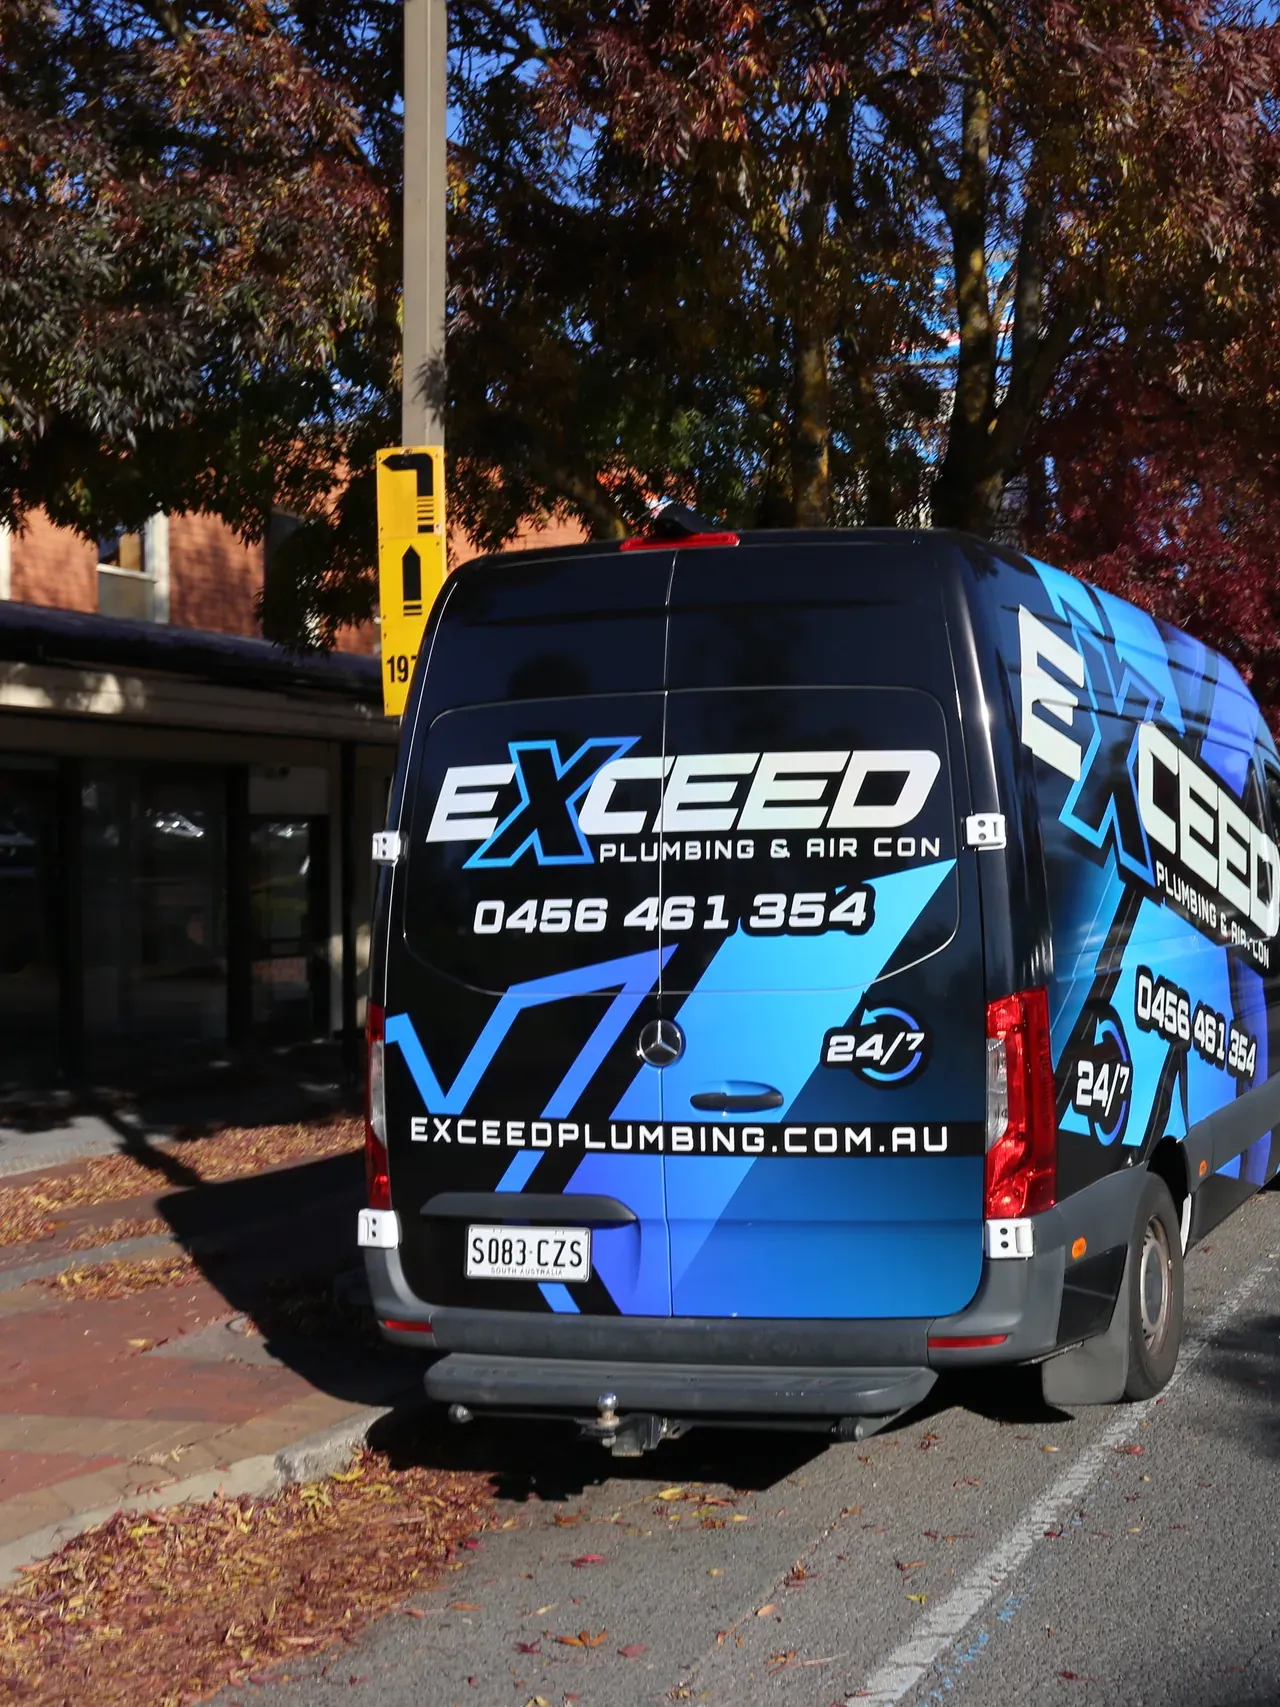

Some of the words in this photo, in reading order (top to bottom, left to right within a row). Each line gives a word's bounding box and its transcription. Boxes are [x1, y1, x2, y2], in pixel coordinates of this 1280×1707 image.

[1019, 604, 1280, 938] EXCEED
[426, 736, 941, 869] EXCEED
[600, 838, 754, 863] PLUMBING
[770, 838, 790, 858] &
[806, 837, 858, 858] AIR
[873, 837, 940, 858] CON
[473, 898, 608, 934] 0456
[623, 895, 730, 931] 461
[749, 891, 867, 928] 354
[1156, 860, 1217, 929] PLUMBING
[826, 1032, 925, 1066] 24/7
[1137, 974, 1190, 1041] 0456
[1194, 1009, 1225, 1061] 461
[1228, 1028, 1256, 1077] 354
[1076, 1060, 1129, 1117] 24/7
[410, 1116, 948, 1153] EXCEEDPLUMBING.COM.AU
[490, 1267, 517, 1275] SOUTH
[520, 1267, 563, 1276] AUSTRALIA
